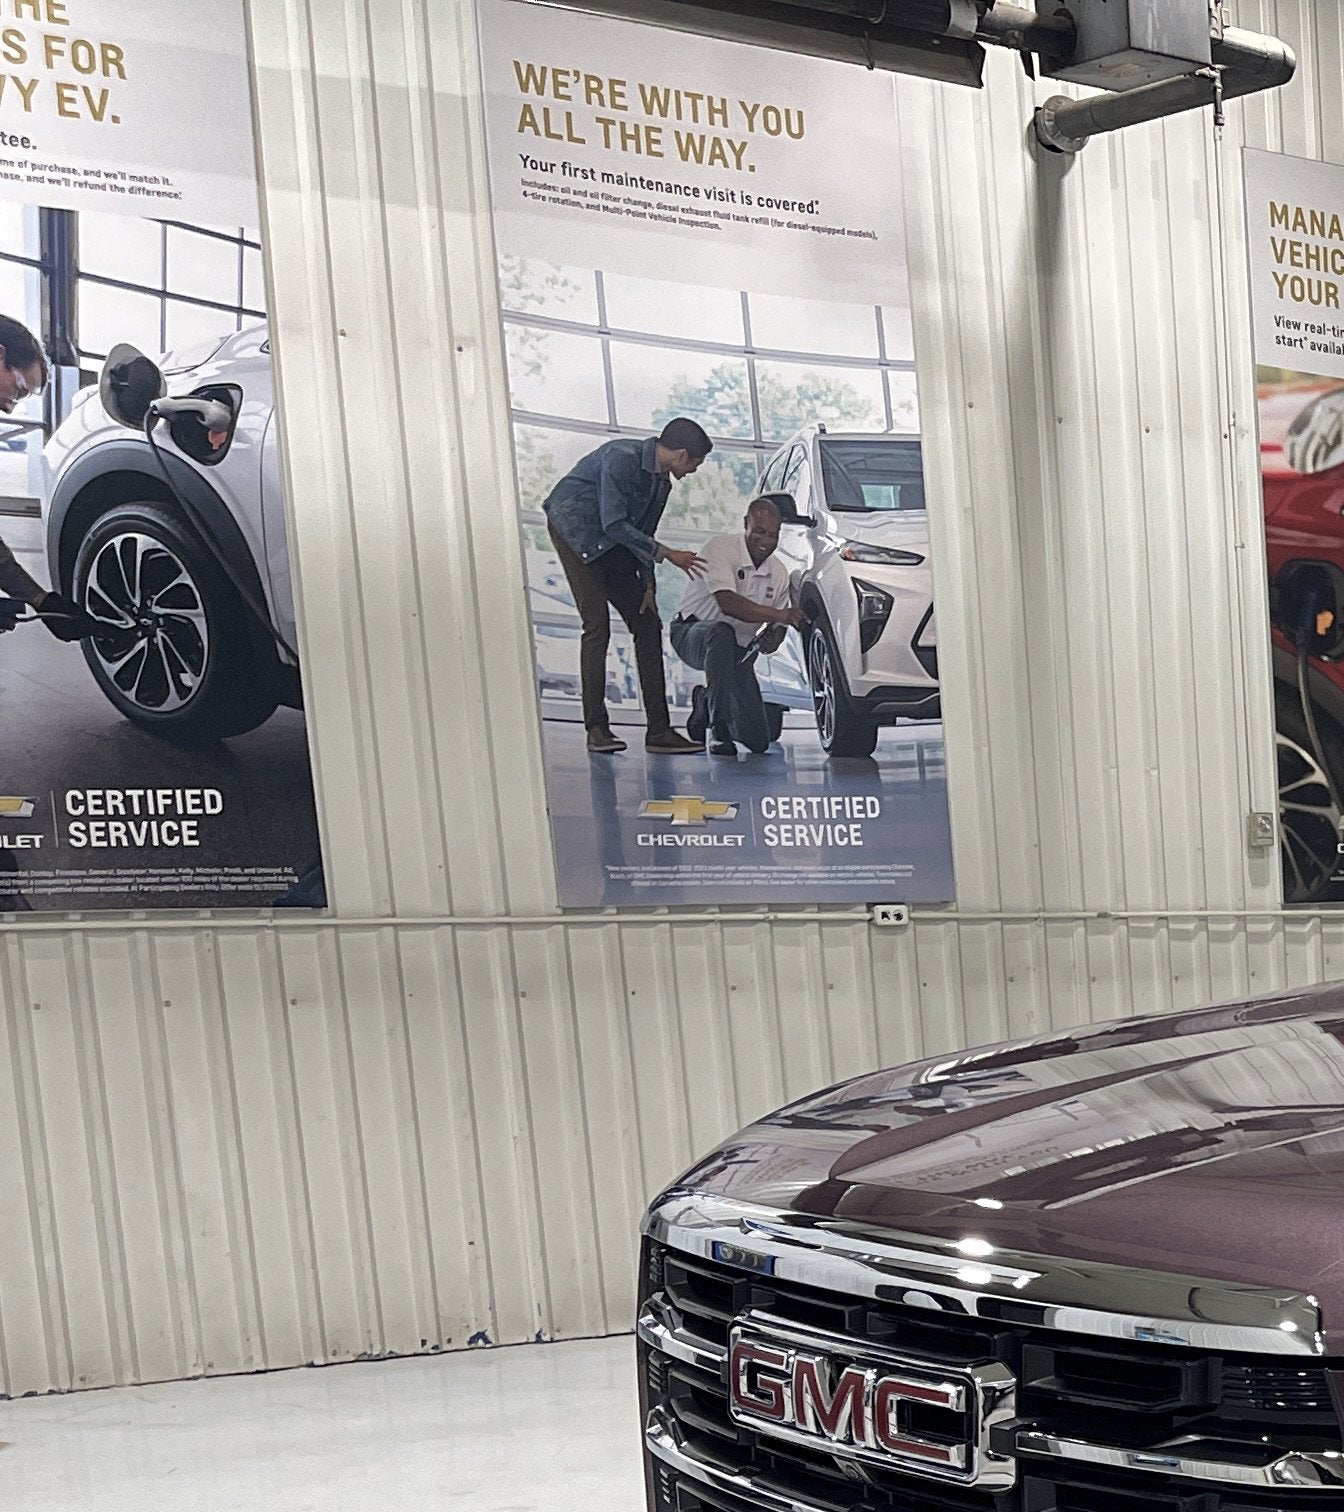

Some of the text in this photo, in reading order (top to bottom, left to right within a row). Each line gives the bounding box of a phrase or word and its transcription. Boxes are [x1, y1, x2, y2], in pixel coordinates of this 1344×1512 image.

[0, 0, 70, 25] HE
[43, 34, 128, 80] FOR
[56, 81, 121, 124] EV.
[512, 60, 806, 140] WE'RE WITH YOU
[517, 103, 757, 172] ALL THE WAY.
[17, 160, 28, 169] of
[31, 163, 81, 177] purchase,
[83, 169, 101, 178] and
[129, 174, 160, 186] match
[26, 175, 45, 184] and
[73, 180, 106, 192] refund
[109, 183, 126, 194] the
[519, 153, 557, 174] Your
[561, 161, 596, 181] first
[601, 172, 700, 198] maintenance
[704, 186, 736, 204] visit
[741, 190, 753, 206] is
[1271, 271, 1340, 310] YOUR
[1274, 314, 1302, 332] View
[65, 788, 223, 816] CERTIFIED
[760, 796, 880, 819] CERTIFIED
[68, 820, 200, 848] SERVICE
[637, 833, 746, 848] CHEVROLET
[763, 823, 864, 847] SERVICE
[732, 1336, 967, 1470] GMC
